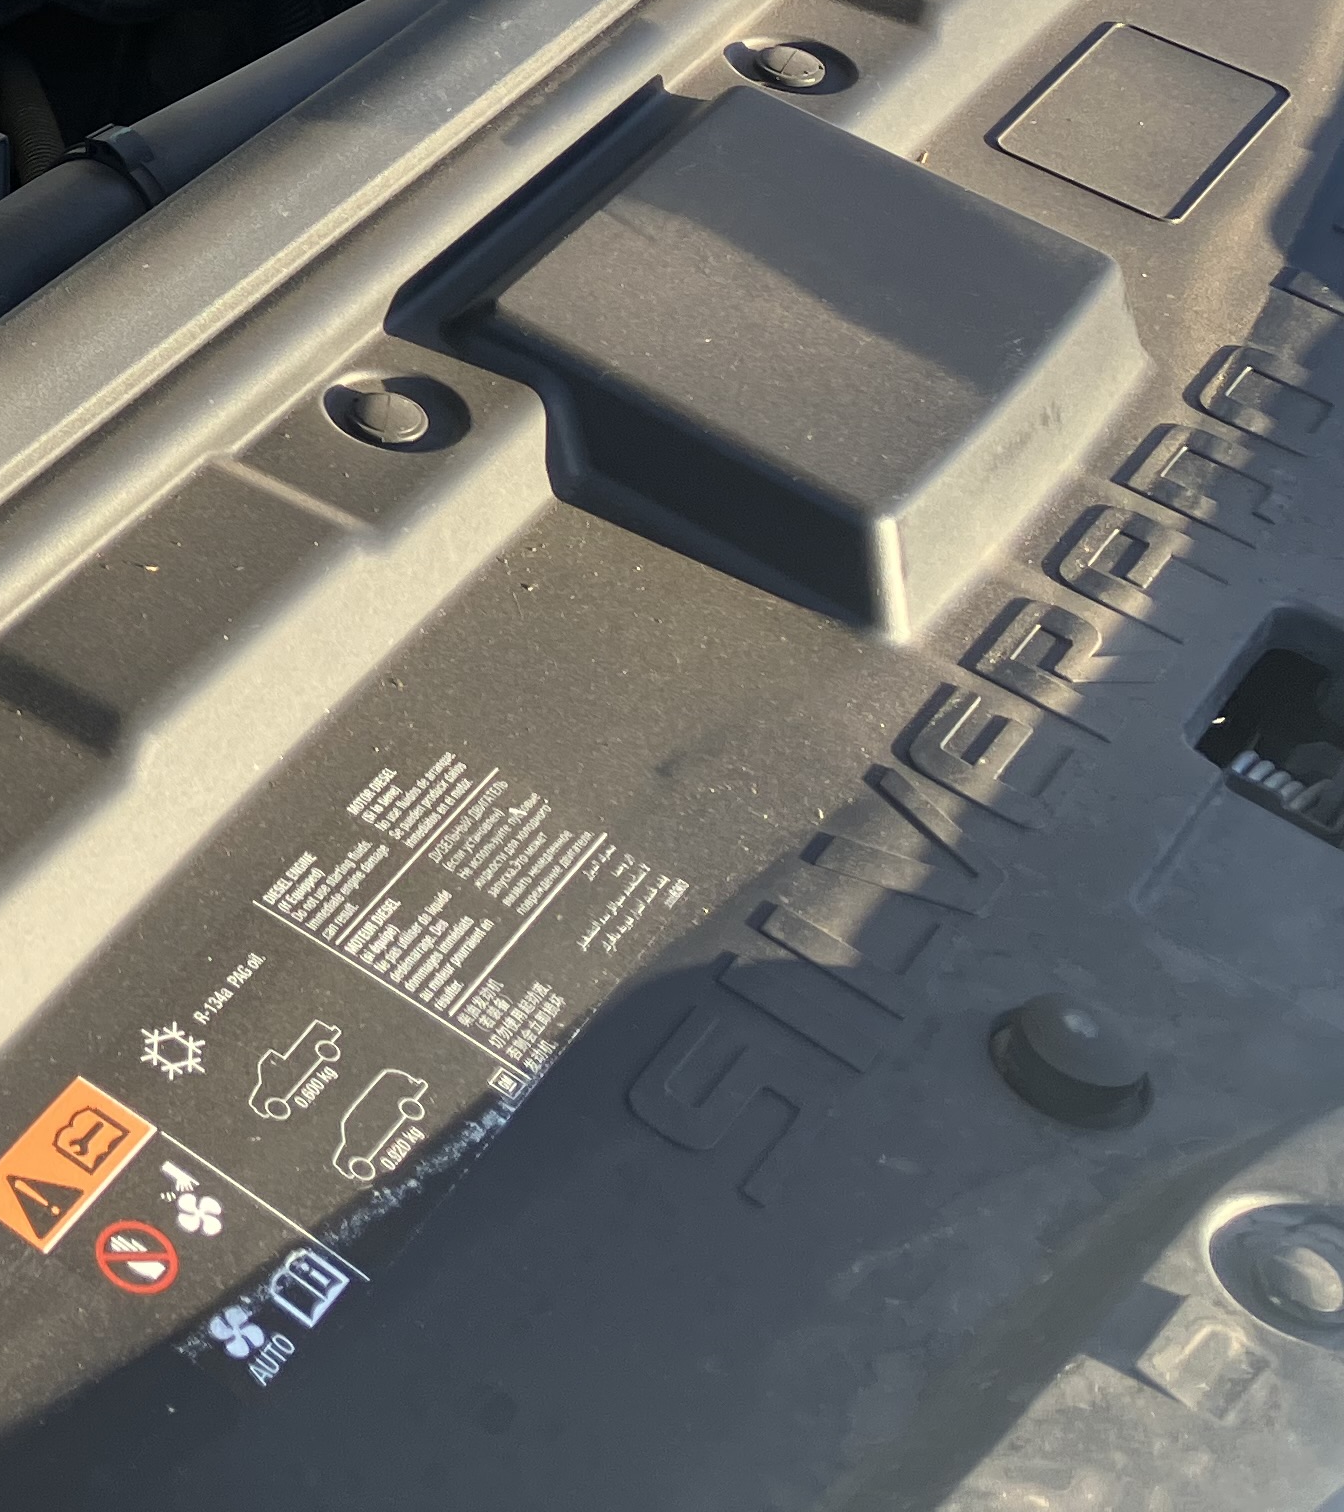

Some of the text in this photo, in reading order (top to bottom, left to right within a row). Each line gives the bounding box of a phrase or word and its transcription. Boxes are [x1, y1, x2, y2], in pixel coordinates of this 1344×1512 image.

[346, 767, 398, 816] MOTOR DIESEL
[436, 802, 450, 815] en
[444, 794, 456, 806] el
[622, 345, 1334, 1210] SILVERADO
[374, 819, 391, 832] No
[385, 807, 402, 822] use
[395, 786, 422, 810] fluidos
[416, 778, 430, 790] de
[388, 828, 405, 840] Se
[399, 804, 426, 832] pueden
[428, 780, 509, 864] ДИЗЕЛЬНЫЙ ДВИГАТЕЛЬ
[441, 807, 506, 873] (если установлен)
[474, 804, 552, 891] жидкости для холодного
[262, 851, 317, 905] DIESEL ENGINE
[285, 867, 326, 905] Equipped)
[290, 840, 373, 923] Do not use starting fluids.
[305, 844, 390, 931] Immediate engine damage
[456, 867, 474, 880] Не
[502, 830, 573, 907] вызвать немедленное
[516, 865, 563, 916] повреждение
[321, 902, 360, 942] can result.
[344, 897, 402, 956] MOTEUR DIESEL
[373, 889, 453, 974] Ne pas utiliser de liquide
[428, 919, 449, 937] Des
[193, 952, 266, 1025] R-134a PAG oil.
[404, 951, 444, 993] dommages
[419, 987, 434, 1002] au
[428, 962, 455, 992] moteur
[449, 926, 487, 968] pourraient
[457, 978, 504, 1028] 柴油发动机
[501, 993, 566, 1061] 否则会立即损坏
[294, 1065, 339, 1109] 0.600 kg
[380, 1125, 426, 1171] 0.920 kg
[249, 1334, 296, 1387] AUTO
